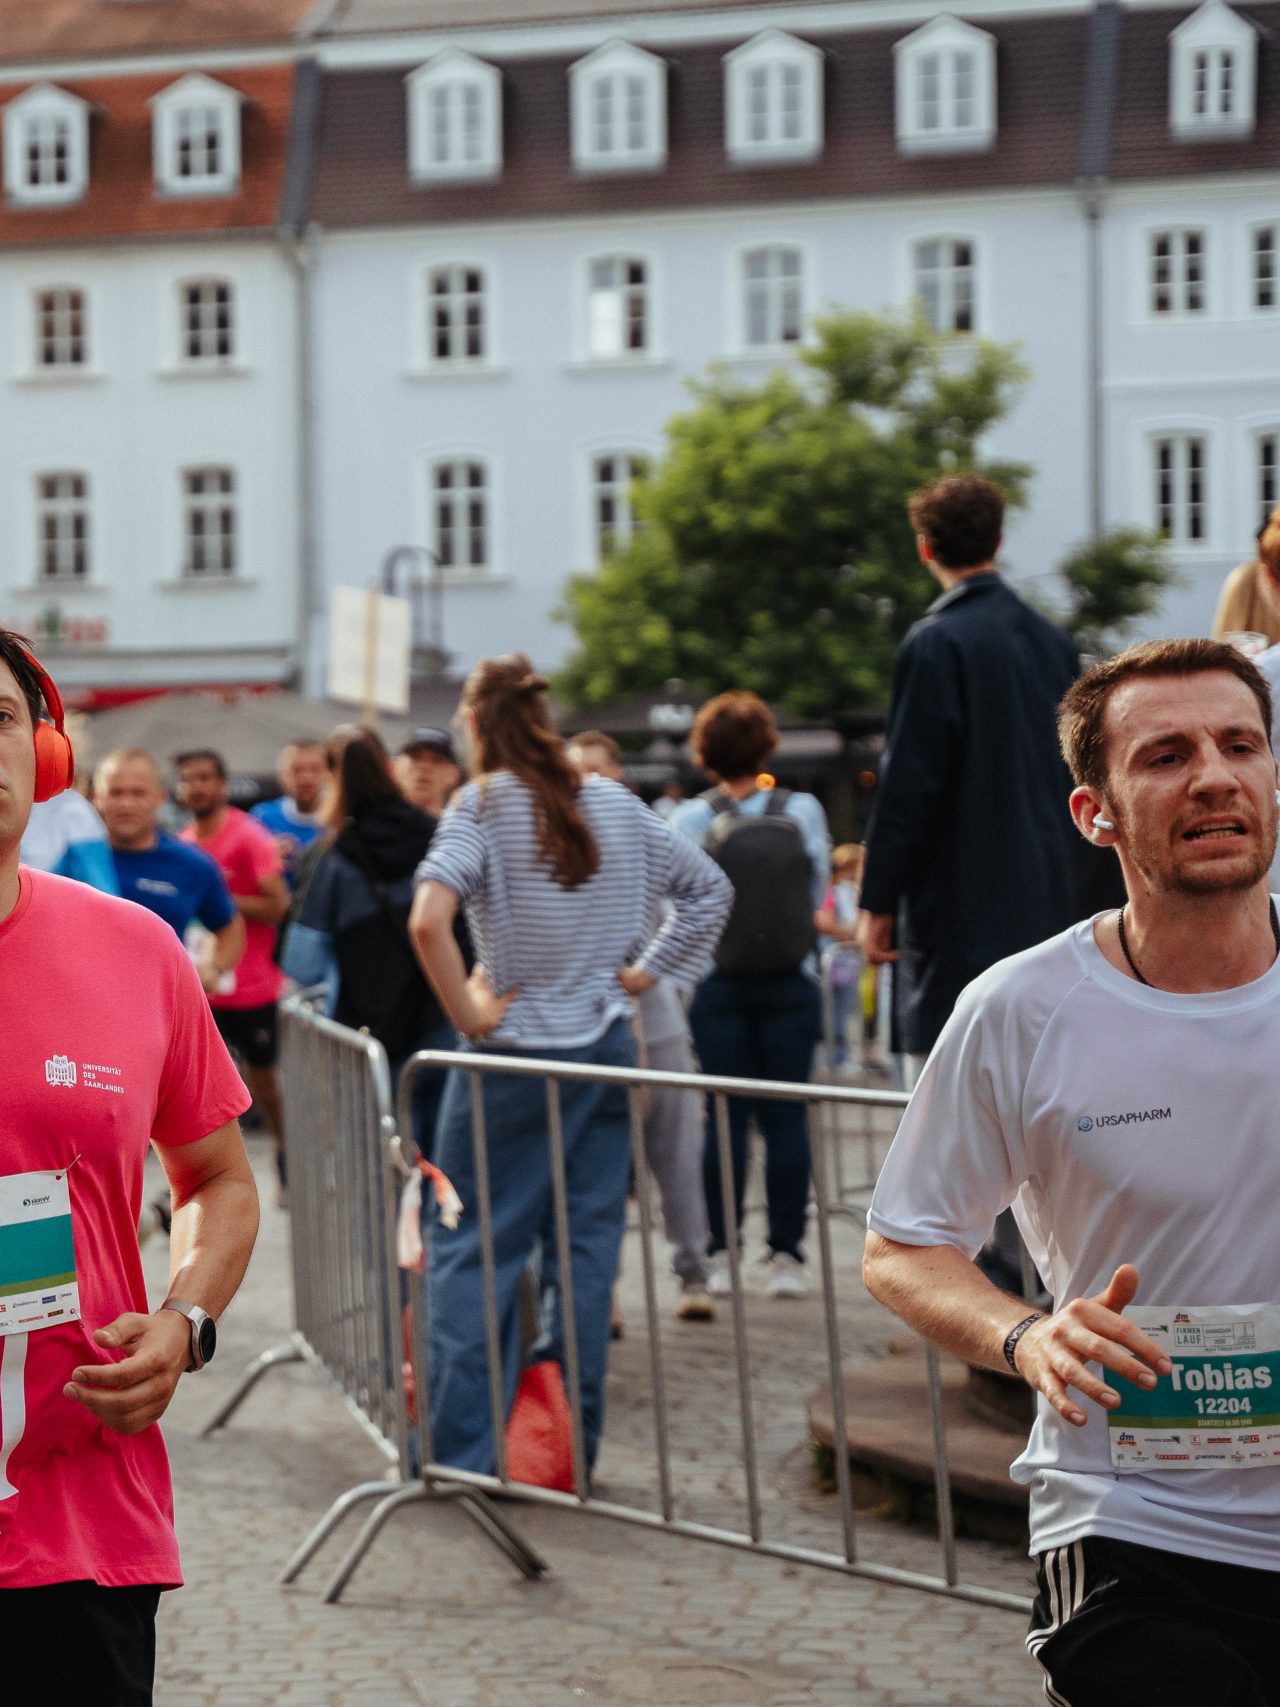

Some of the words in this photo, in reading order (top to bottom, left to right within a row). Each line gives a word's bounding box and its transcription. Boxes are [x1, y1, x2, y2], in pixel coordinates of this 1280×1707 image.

[82, 1063, 122, 1075] UNIVERSITÄT
[83, 1071, 96, 1079] DES
[83, 1080, 125, 1094] SAARLANDES
[1096, 1107, 1172, 1127] URSAPHARM
[1175, 1312, 1189, 1320] dm
[1177, 1334, 1202, 1345] LAUF
[1171, 1363, 1272, 1391] Tobias
[1195, 1397, 1252, 1414] 12204
[1119, 1432, 1135, 1441] dm
